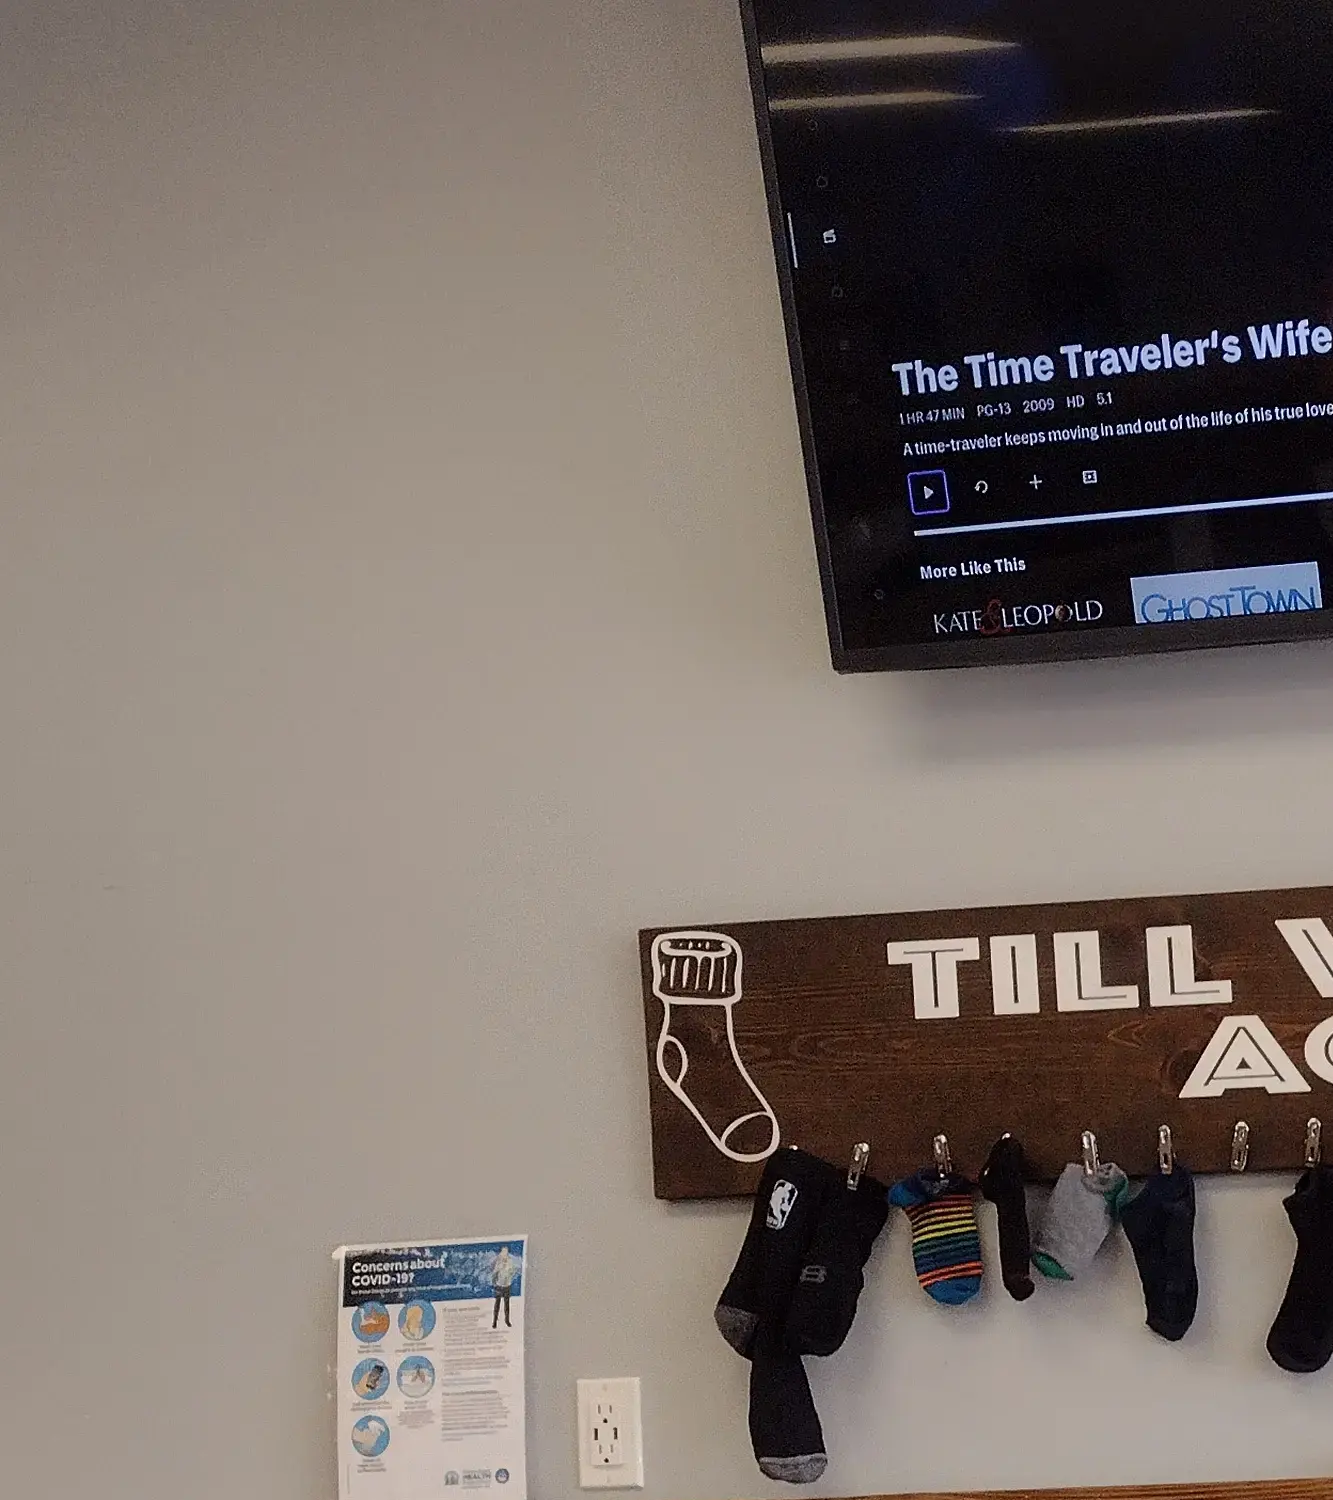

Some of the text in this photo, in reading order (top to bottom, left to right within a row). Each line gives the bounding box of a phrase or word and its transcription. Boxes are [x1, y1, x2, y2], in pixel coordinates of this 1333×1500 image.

[892, 319, 1333, 396] The Time Traveler's Wife
[906, 412, 923, 425] HR
[926, 409, 939, 422] 47
[942, 407, 965, 420] MIN
[977, 403, 1011, 417] PG-13
[1023, 398, 1054, 414] 2009
[1067, 395, 1084, 408] HD
[1097, 391, 1112, 406] 5.1
[903, 443, 913, 456] A
[914, 434, 1002, 455] time-traveler
[1005, 431, 1045, 447] keeps
[1048, 425, 1099, 442] moving
[1101, 423, 1113, 436] in
[1116, 419, 1141, 436] and
[1145, 418, 1167, 432] out
[1170, 415, 1183, 430] of
[1185, 413, 1208, 428] the
[1211, 411, 1232, 426] life
[1235, 408, 1249, 424] of
[1251, 407, 1272, 422] his
[1275, 406, 1303, 421] true
[920, 557, 1026, 580] More Like This
[933, 610, 983, 634] KATE
[1002, 599, 1104, 628] LEOPOLD
[1141, 585, 1317, 623] GHOST TOWN
[887, 925, 1233, 1020] TILL
[351, 1272, 415, 1287] COVID-19?
[352, 1258, 445, 1274] Concerns about
